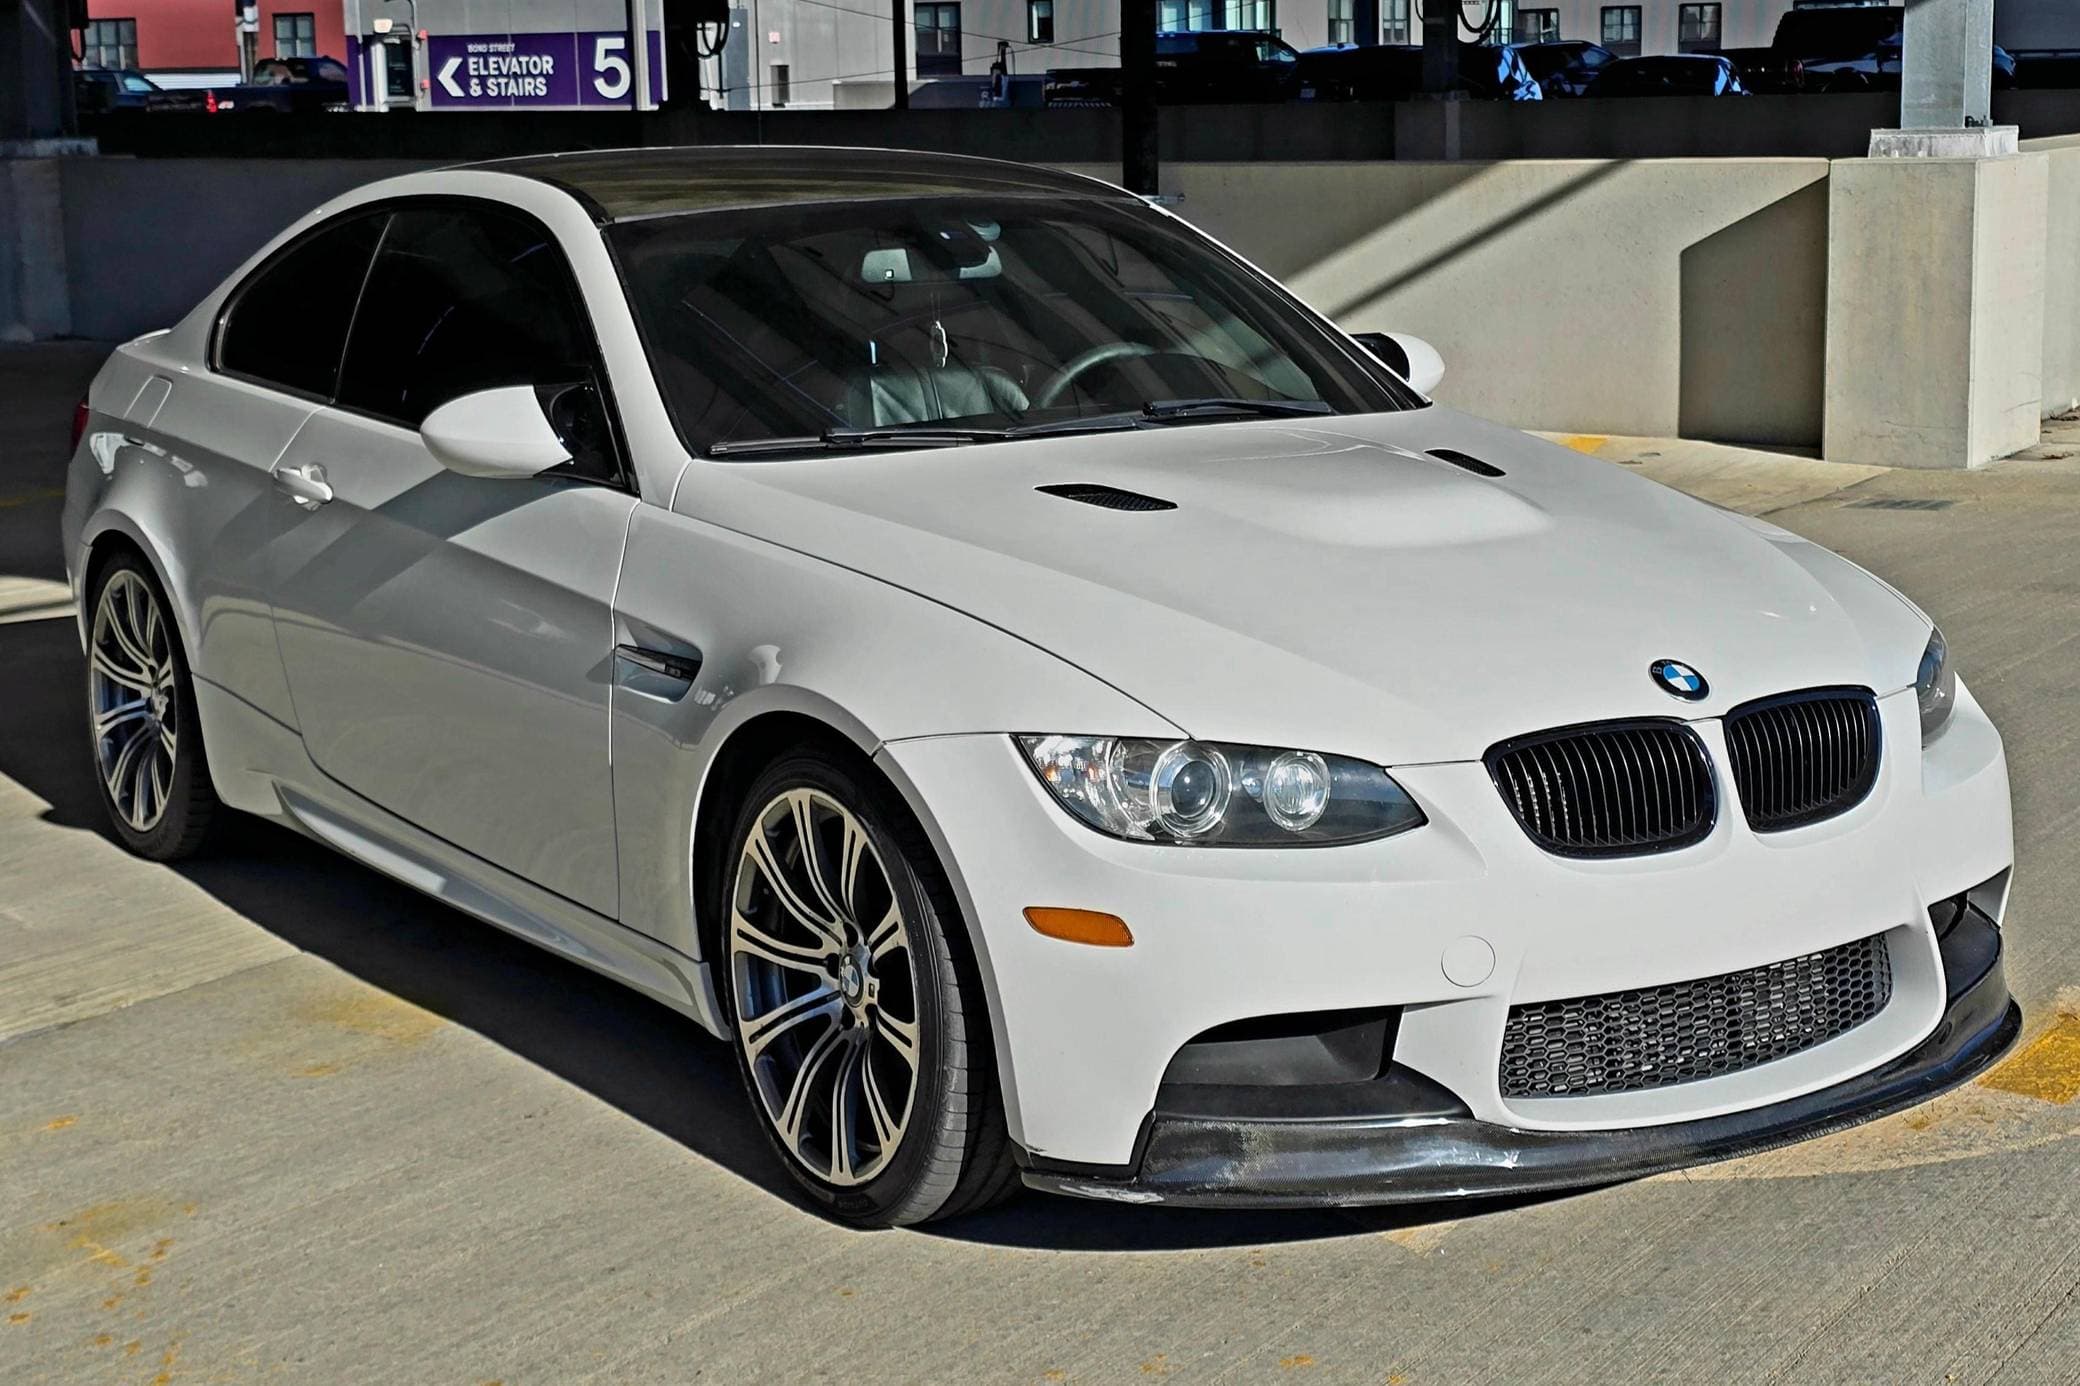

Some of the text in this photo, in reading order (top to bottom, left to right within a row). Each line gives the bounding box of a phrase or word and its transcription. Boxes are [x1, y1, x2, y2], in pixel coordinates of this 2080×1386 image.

[489, 43, 515, 53] STREET
[468, 55, 554, 75] ELEVATOR
[594, 37, 631, 99] 5
[469, 76, 547, 97] & STAIRS
